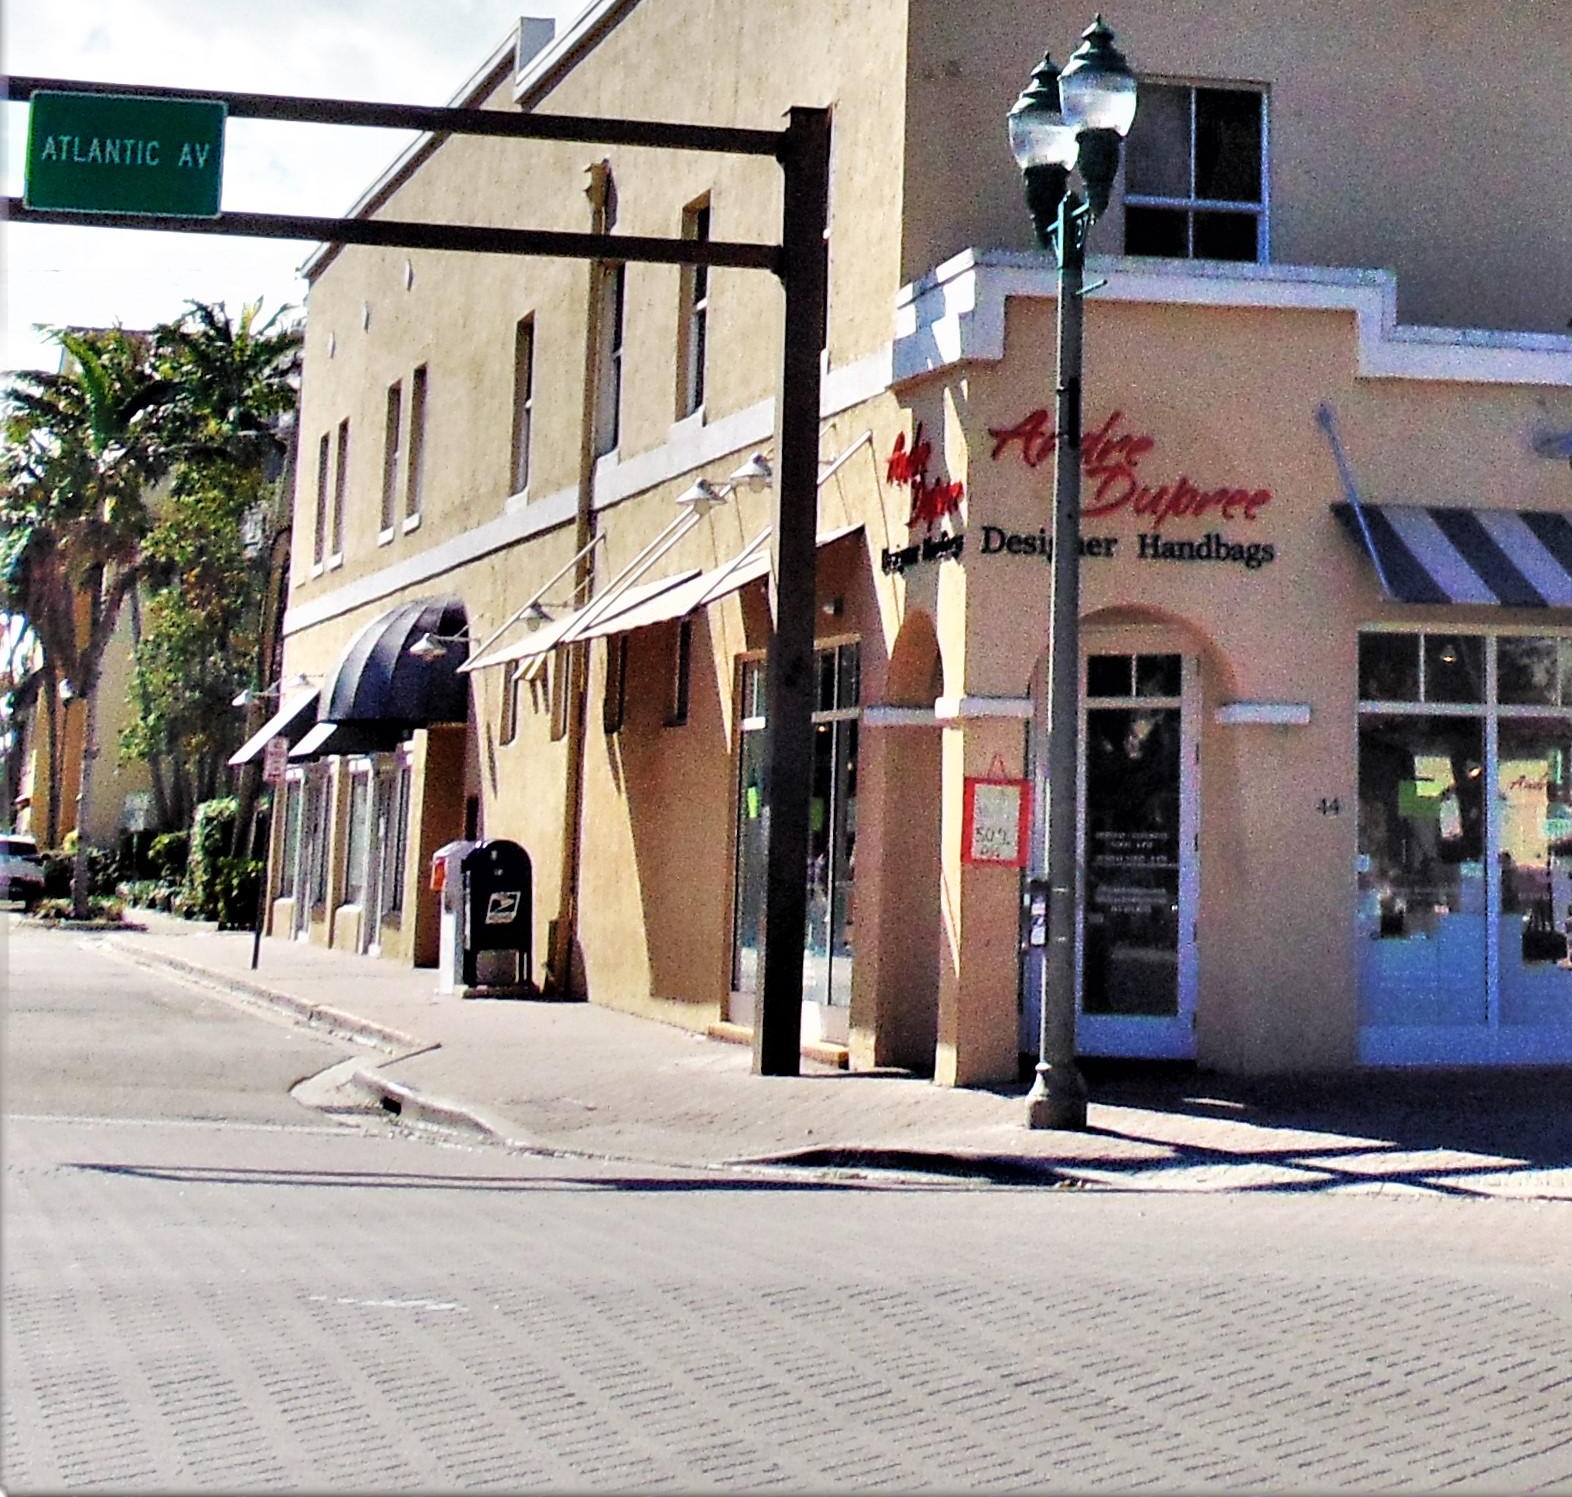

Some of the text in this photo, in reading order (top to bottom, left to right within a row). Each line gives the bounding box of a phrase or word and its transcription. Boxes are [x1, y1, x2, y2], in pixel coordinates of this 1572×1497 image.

[41, 135, 210, 168] ATLANTIC AV
[1081, 465, 1274, 530] Dupree
[1137, 532, 1275, 569] Handbags
